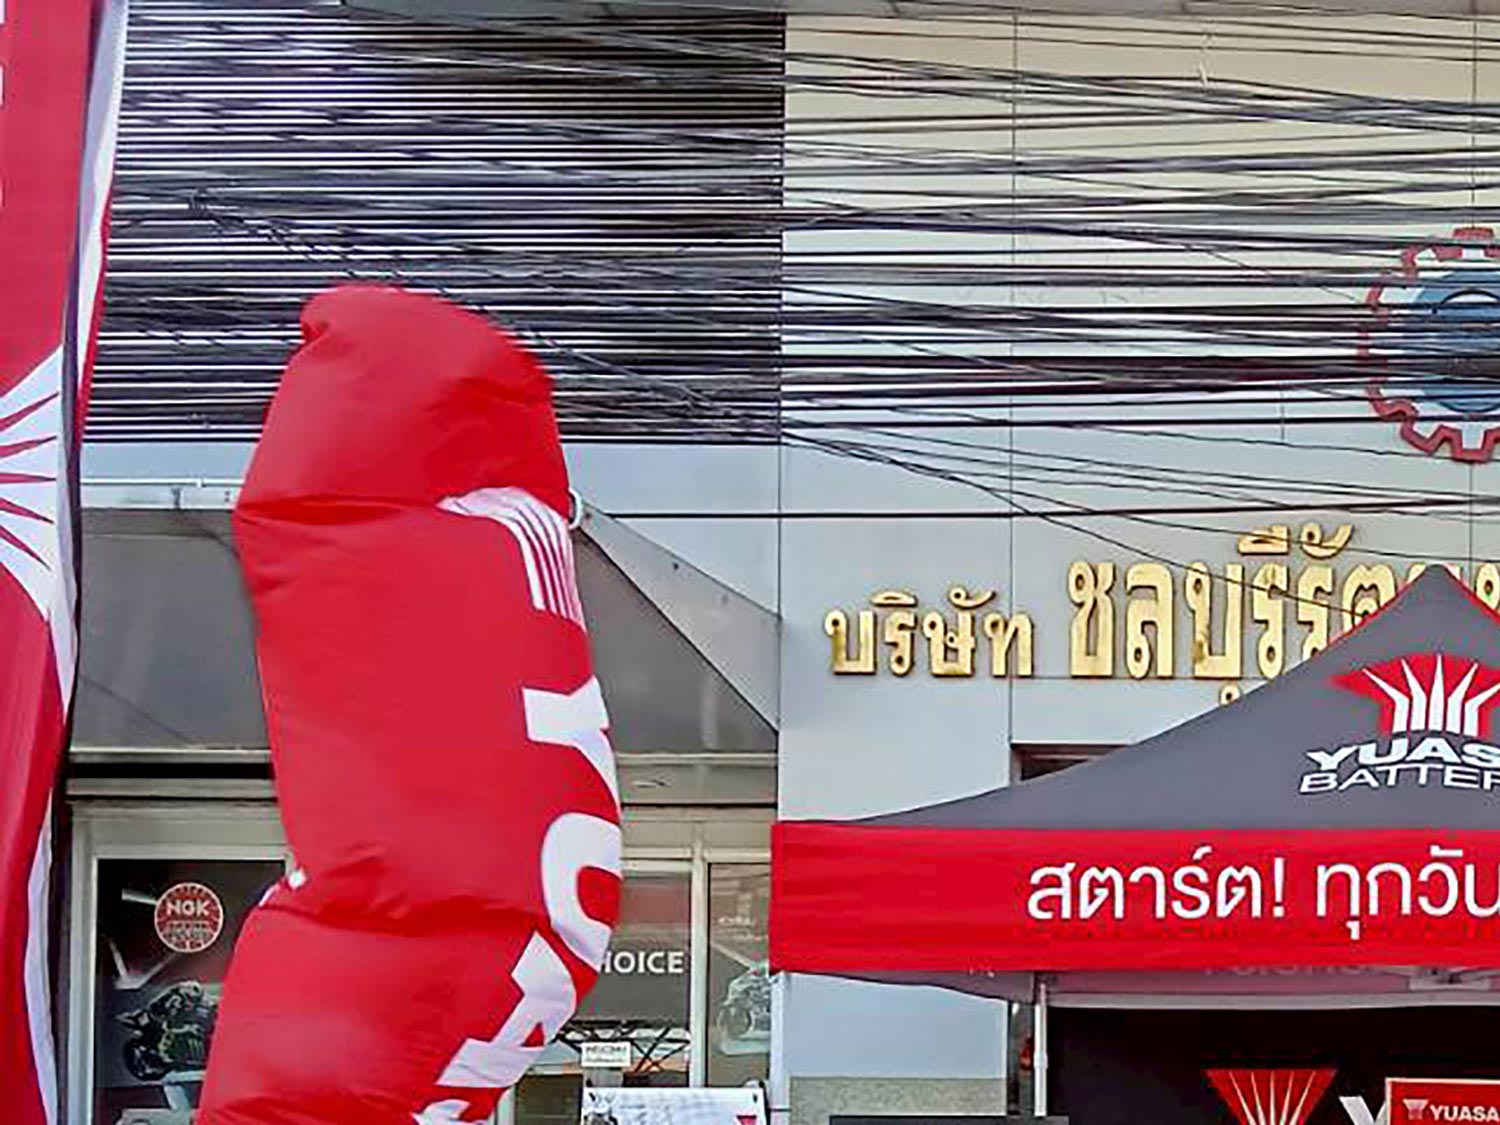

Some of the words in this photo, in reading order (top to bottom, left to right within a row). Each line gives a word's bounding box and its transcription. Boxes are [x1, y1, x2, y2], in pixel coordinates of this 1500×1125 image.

[824, 586, 1035, 677] บริษัท
[1026, 845, 1284, 920] สตาร์ต!
[166, 901, 210, 916] NGK
[1429, 1105, 1500, 1122] YUASA
